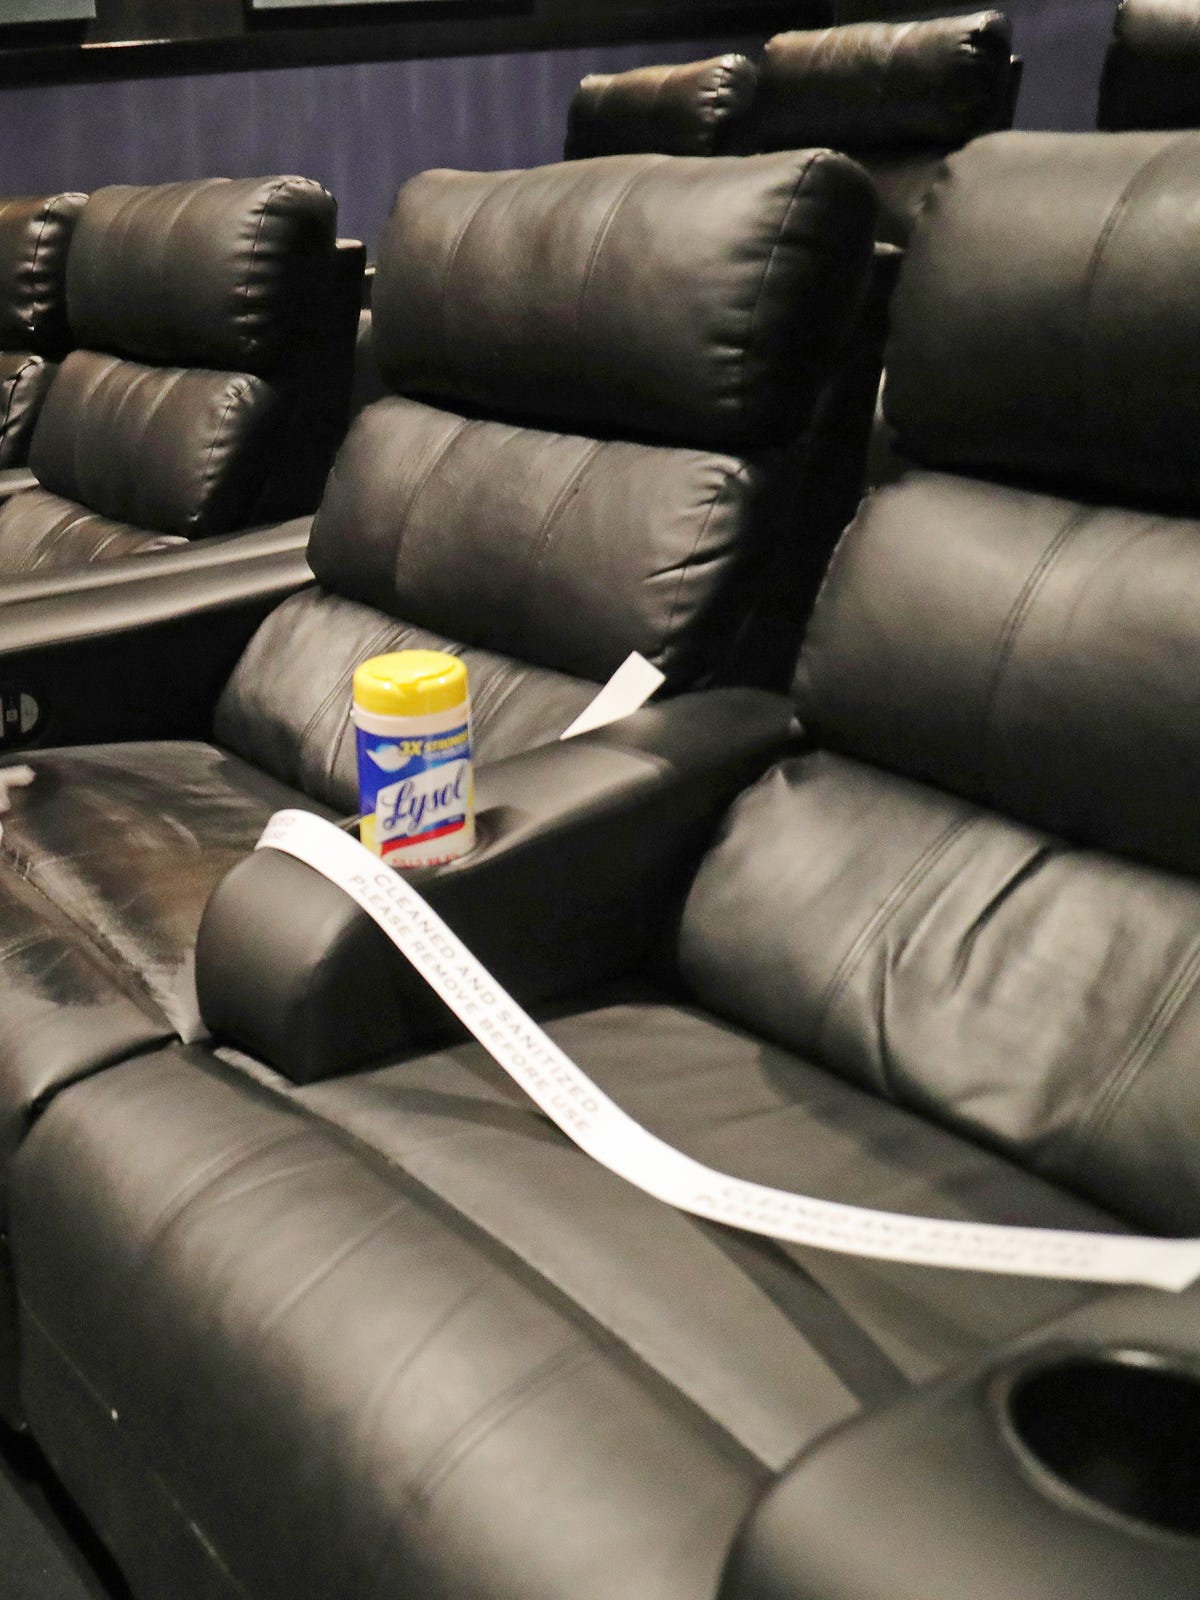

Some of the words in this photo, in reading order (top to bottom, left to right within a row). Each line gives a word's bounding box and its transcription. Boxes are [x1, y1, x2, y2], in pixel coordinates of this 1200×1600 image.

[381, 764, 464, 833] Lysol
[350, 875, 411, 936] PLEASE
[412, 940, 478, 1014] REMOVE
[478, 1018, 550, 1090] BEFORE
[374, 874, 455, 959] CLEANED
[457, 965, 496, 1005] AND
[496, 1010, 599, 1112] SANITIZED
